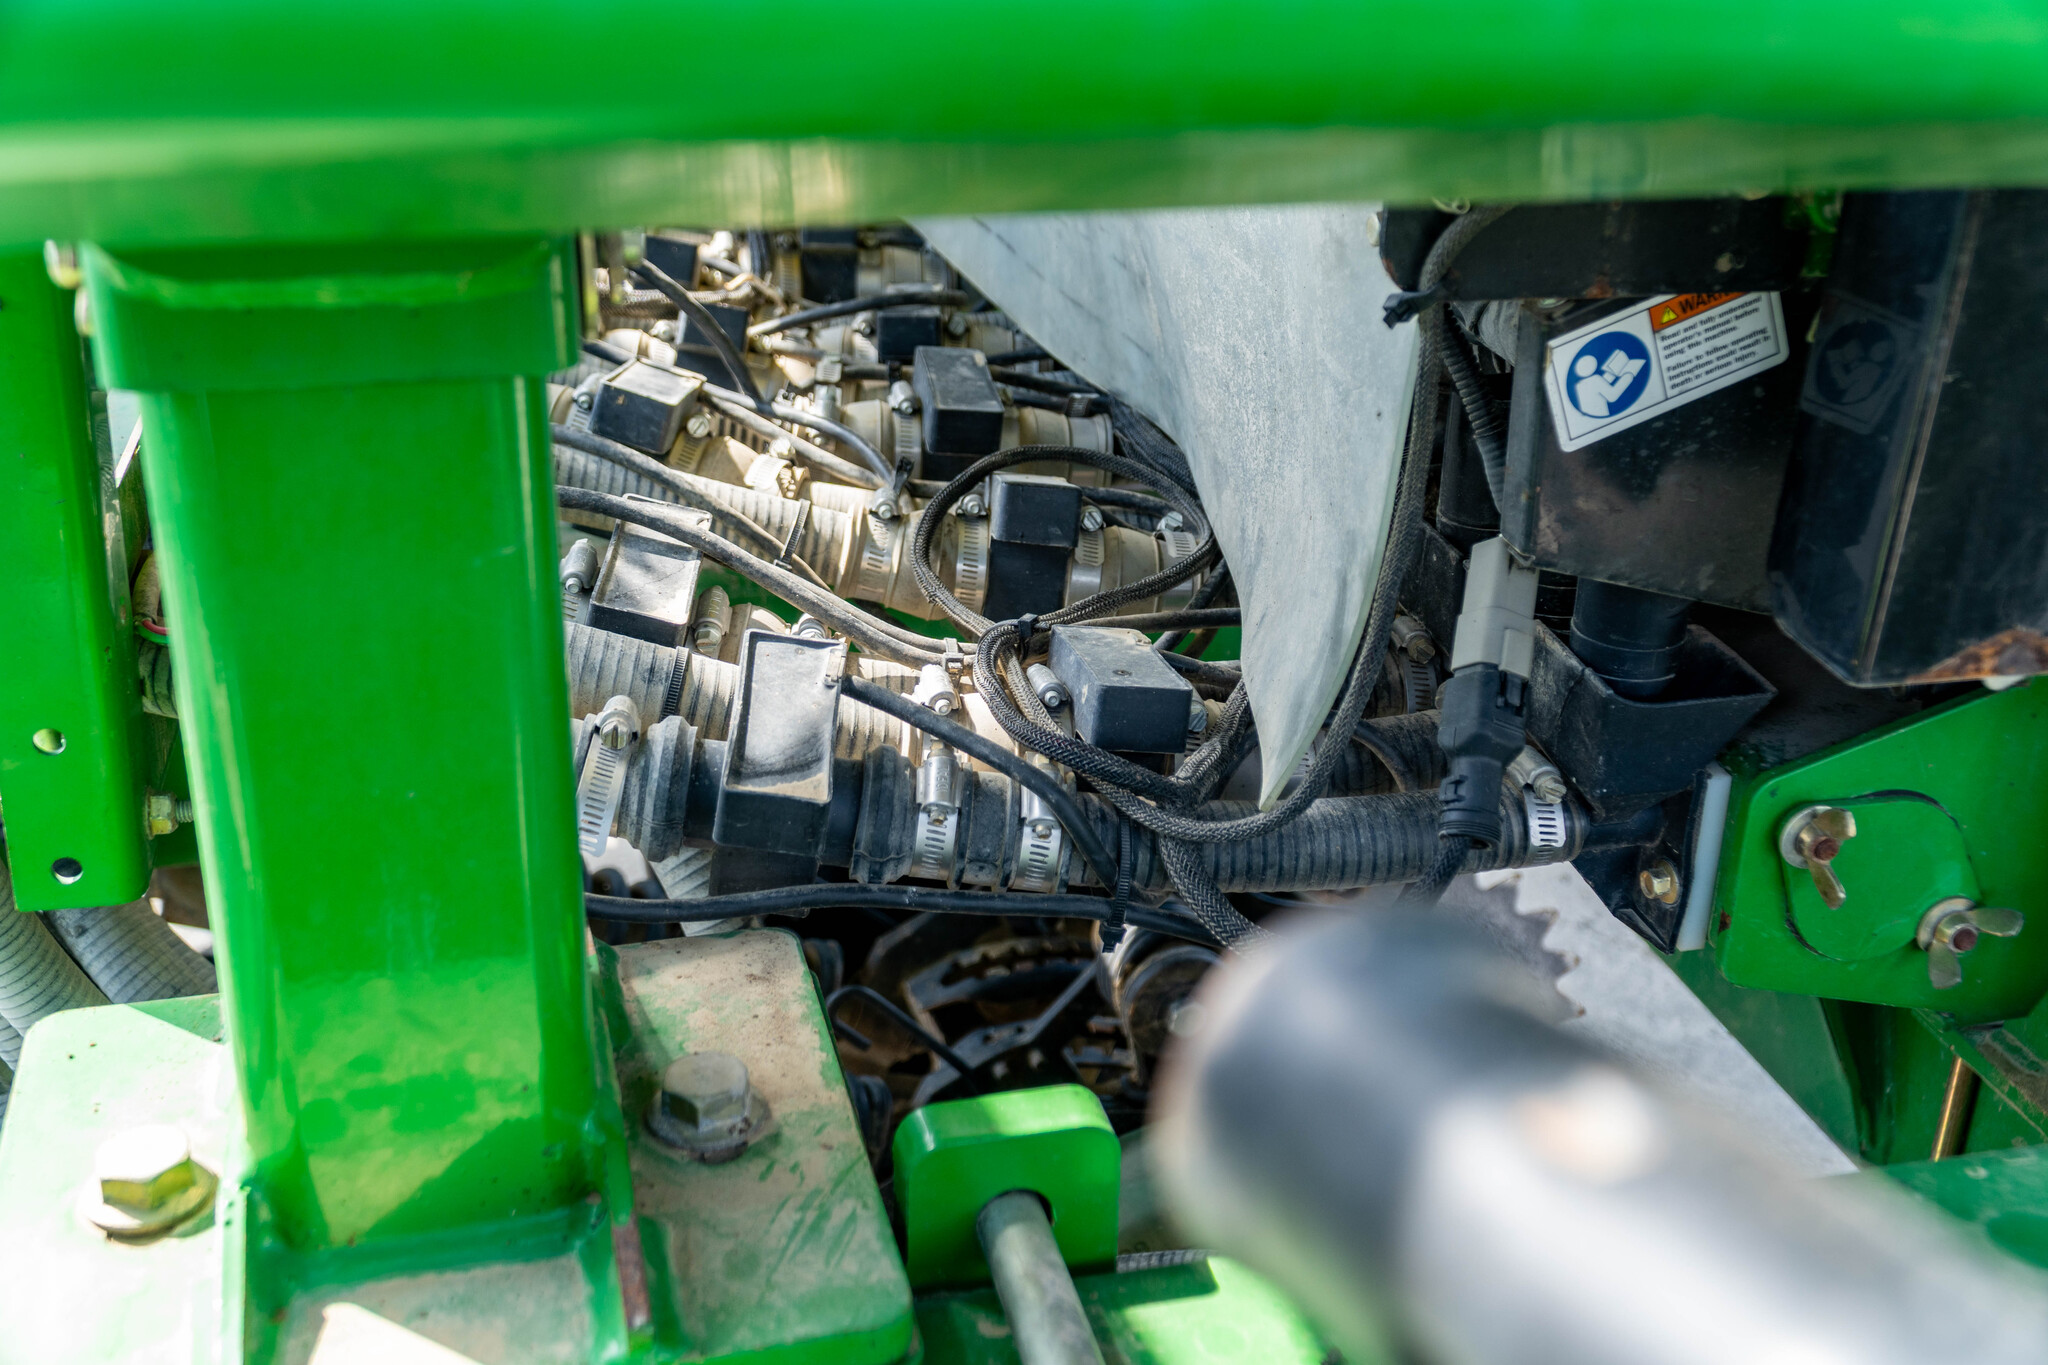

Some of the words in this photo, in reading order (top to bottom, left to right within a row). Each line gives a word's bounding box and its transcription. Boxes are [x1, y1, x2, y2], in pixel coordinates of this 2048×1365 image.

[1665, 347, 1684, 360] using
[1688, 339, 1701, 349] this
[1666, 358, 1692, 373] Failure
[1706, 344, 1728, 356] follow
[935, 764, 949, 792] IDEAL
